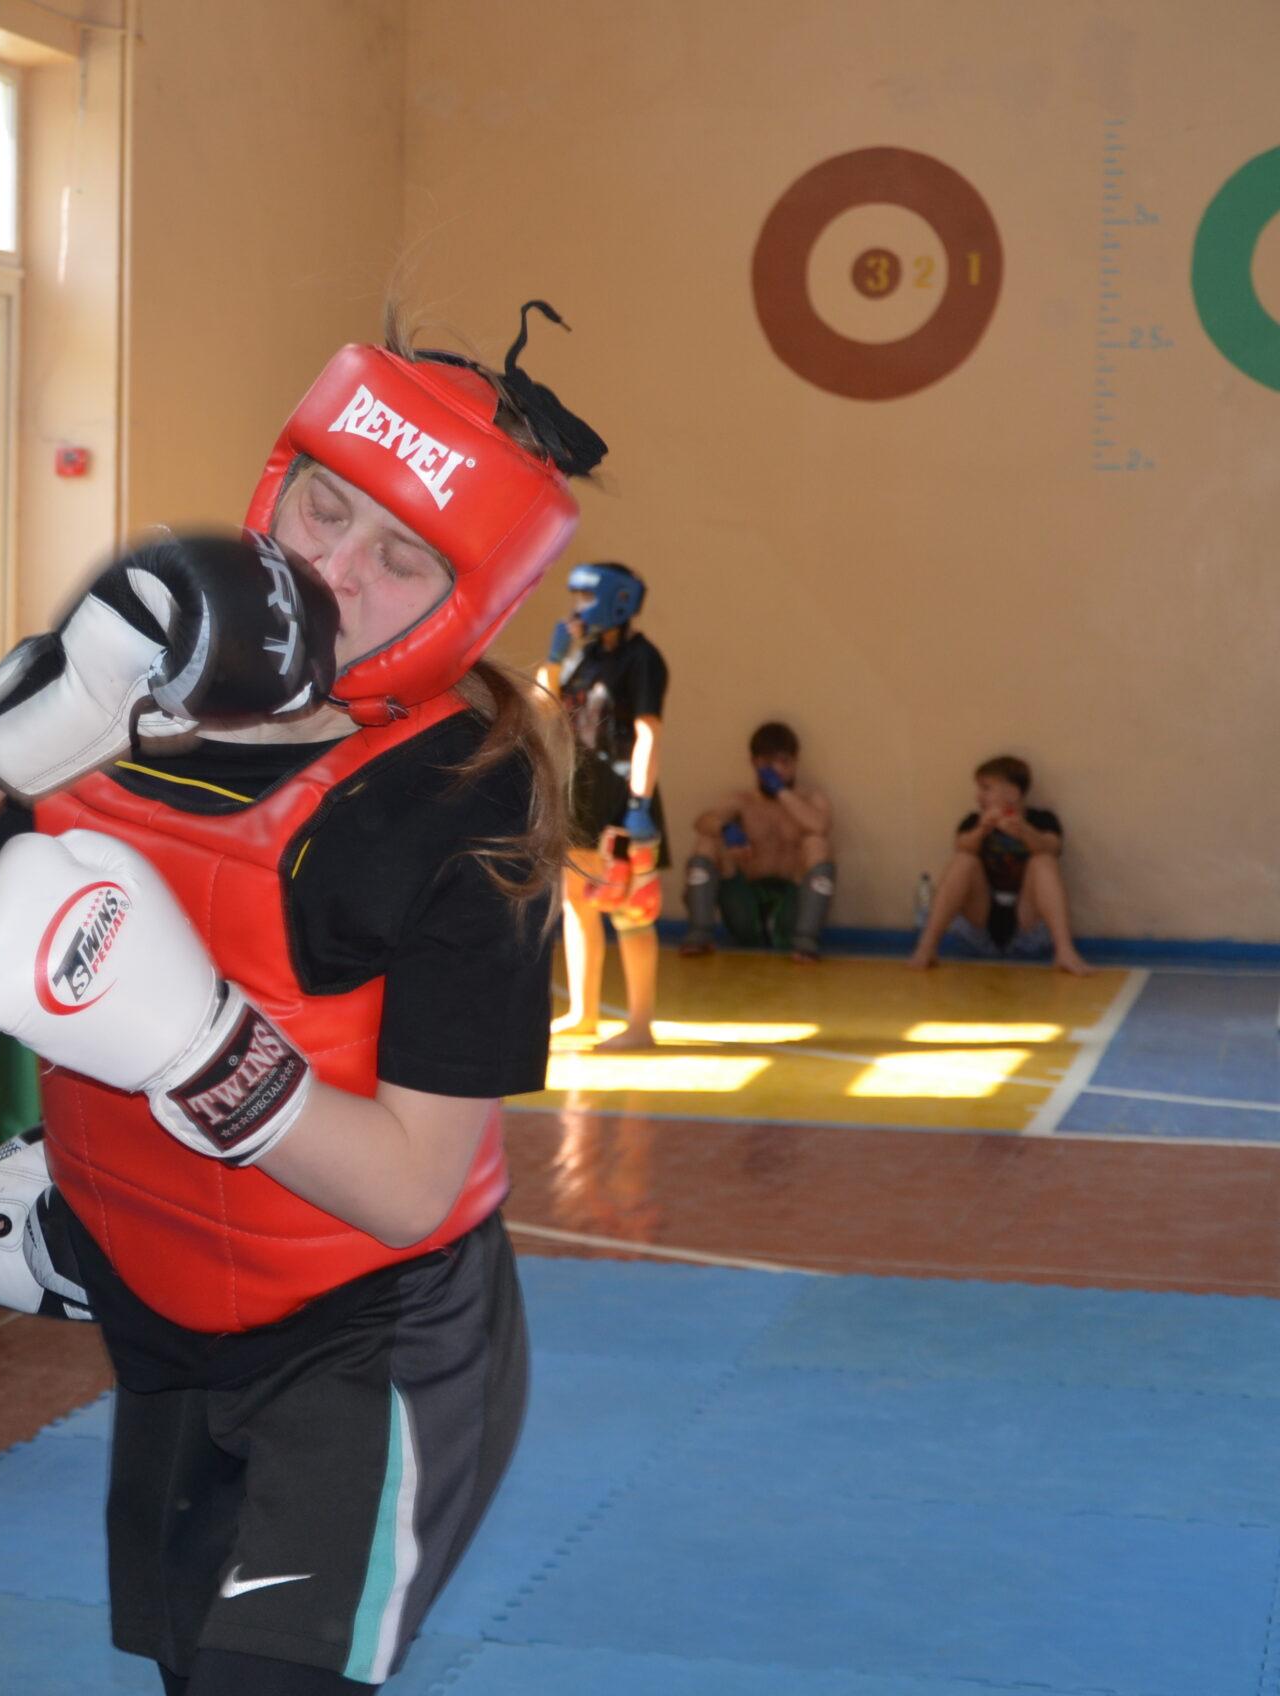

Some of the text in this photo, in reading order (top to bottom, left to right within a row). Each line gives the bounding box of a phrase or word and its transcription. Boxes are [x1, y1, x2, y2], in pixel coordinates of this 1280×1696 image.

[866, 252, 981, 292] 3 2 1
[327, 383, 466, 512] REYVEL
[52, 889, 118, 1002] TWINS
[186, 1021, 289, 1126] TWINS
[246, 1083, 284, 1120] SPECIAL
